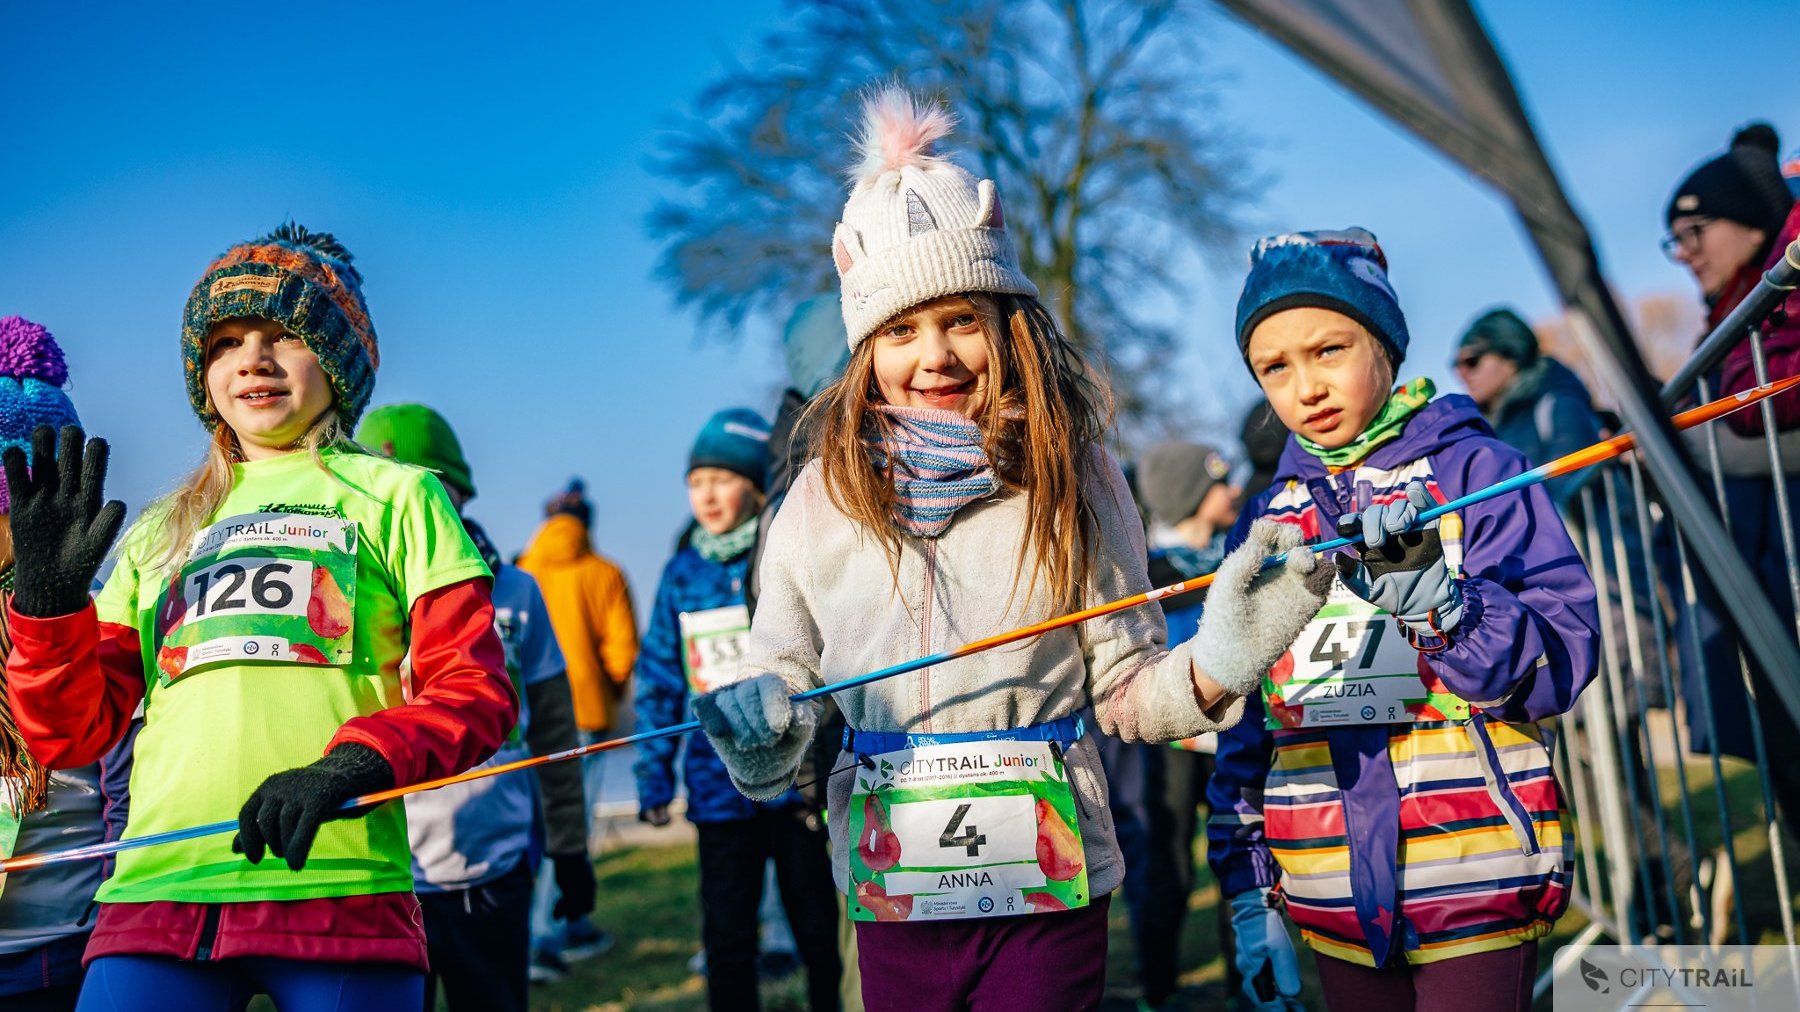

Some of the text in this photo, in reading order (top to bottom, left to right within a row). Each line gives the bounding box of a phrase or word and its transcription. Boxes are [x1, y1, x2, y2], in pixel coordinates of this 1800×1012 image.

[279, 524, 329, 539] Junior
[193, 563, 293, 617] 126
[711, 637, 742, 665] 53
[1310, 620, 1386, 670] 47
[1323, 683, 1376, 698] ZUZIA
[900, 755, 989, 775] CITYTRAiL
[995, 753, 1038, 768] Junior
[939, 804, 987, 857] 4
[938, 872, 993, 889] ANNA
